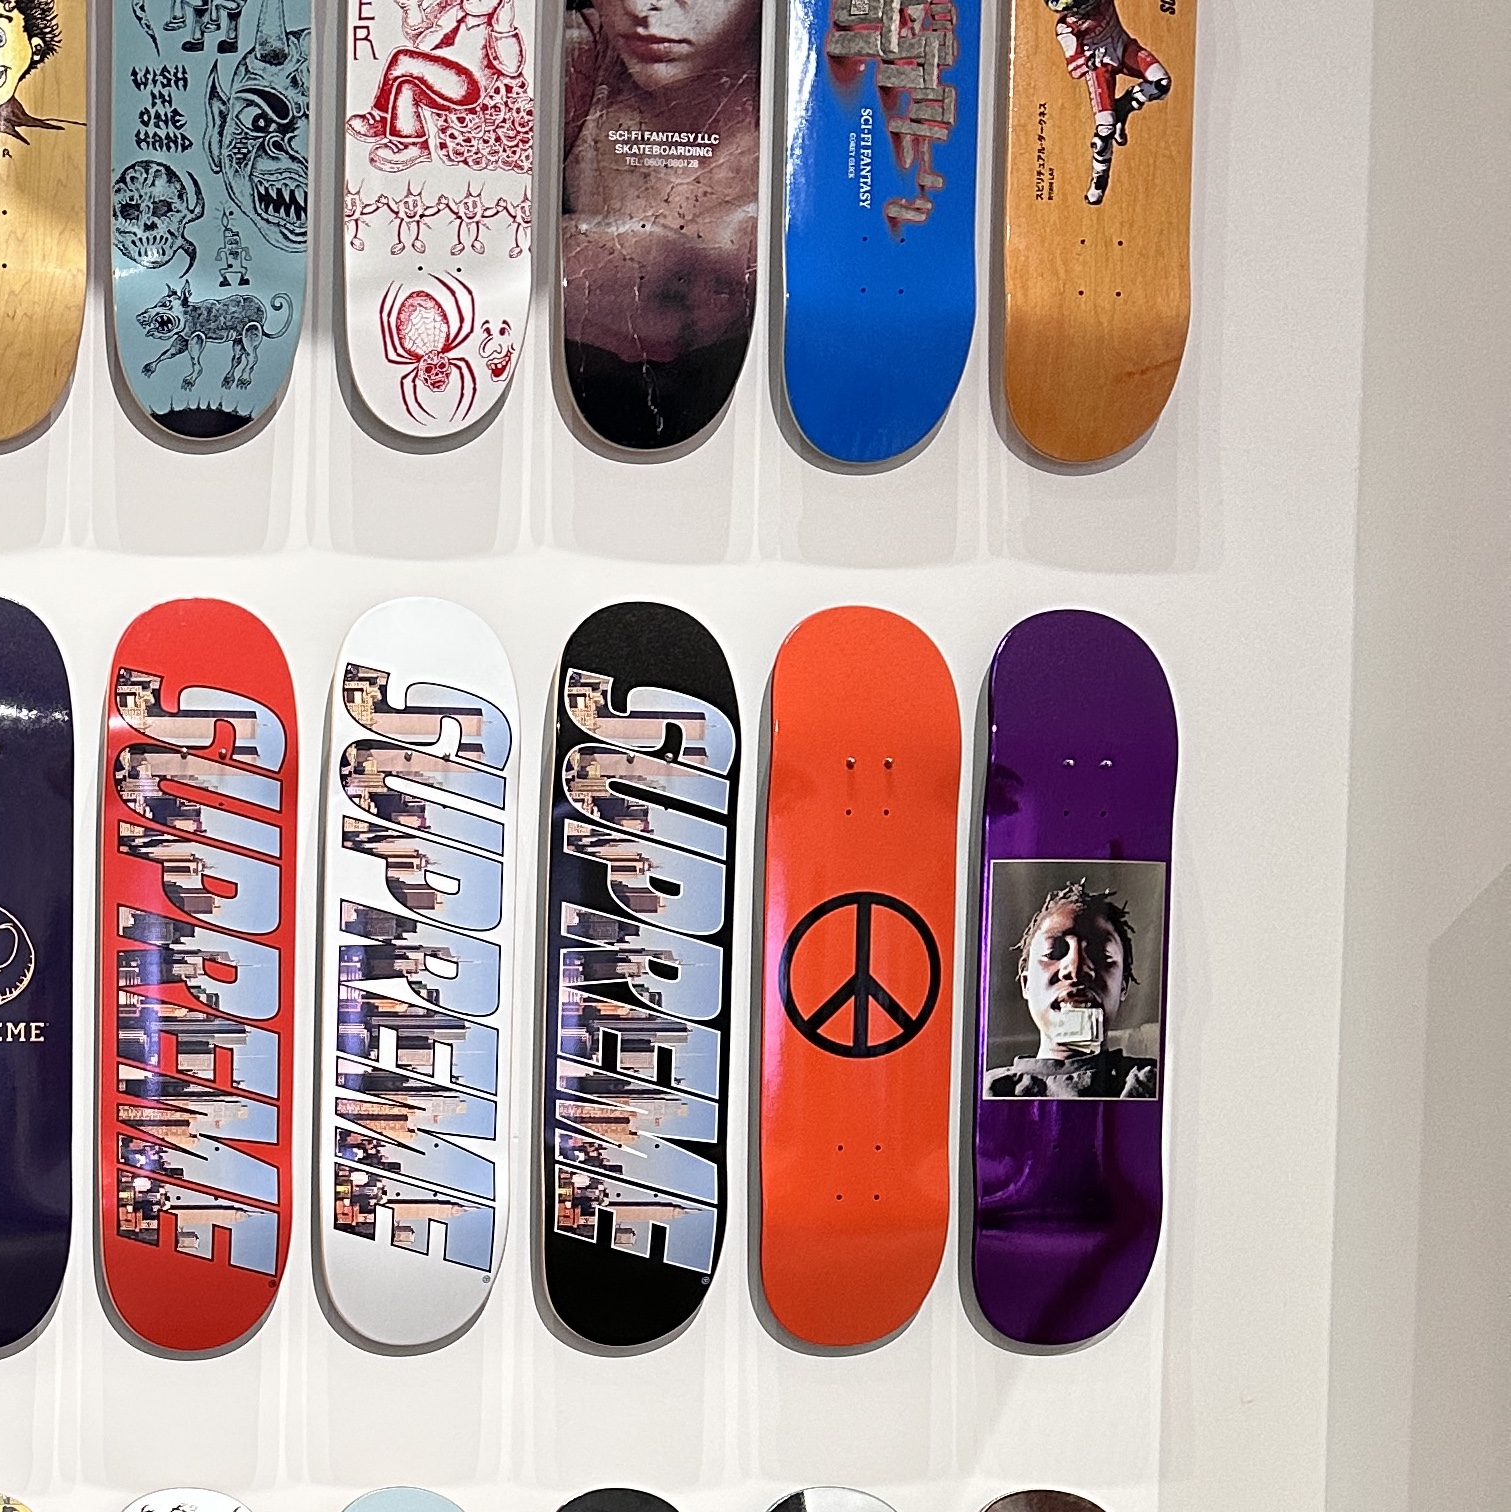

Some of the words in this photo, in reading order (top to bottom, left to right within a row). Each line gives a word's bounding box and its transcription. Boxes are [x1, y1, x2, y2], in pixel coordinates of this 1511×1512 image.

[130, 64, 189, 92] WISH
[150, 89, 173, 109] IN
[138, 107, 188, 131] ONE
[860, 108, 873, 146] SCI-FI
[134, 128, 194, 153] HAND
[608, 130, 642, 141] SCI-FI
[644, 131, 696, 143] FANTASY
[615, 144, 713, 157] SKATEBOARDING
[859, 149, 872, 209] FANTASY
[113, 667, 288, 1279] SUPREME
[338, 660, 514, 1274] SUPREME
[554, 667, 737, 1276] SUPREME
